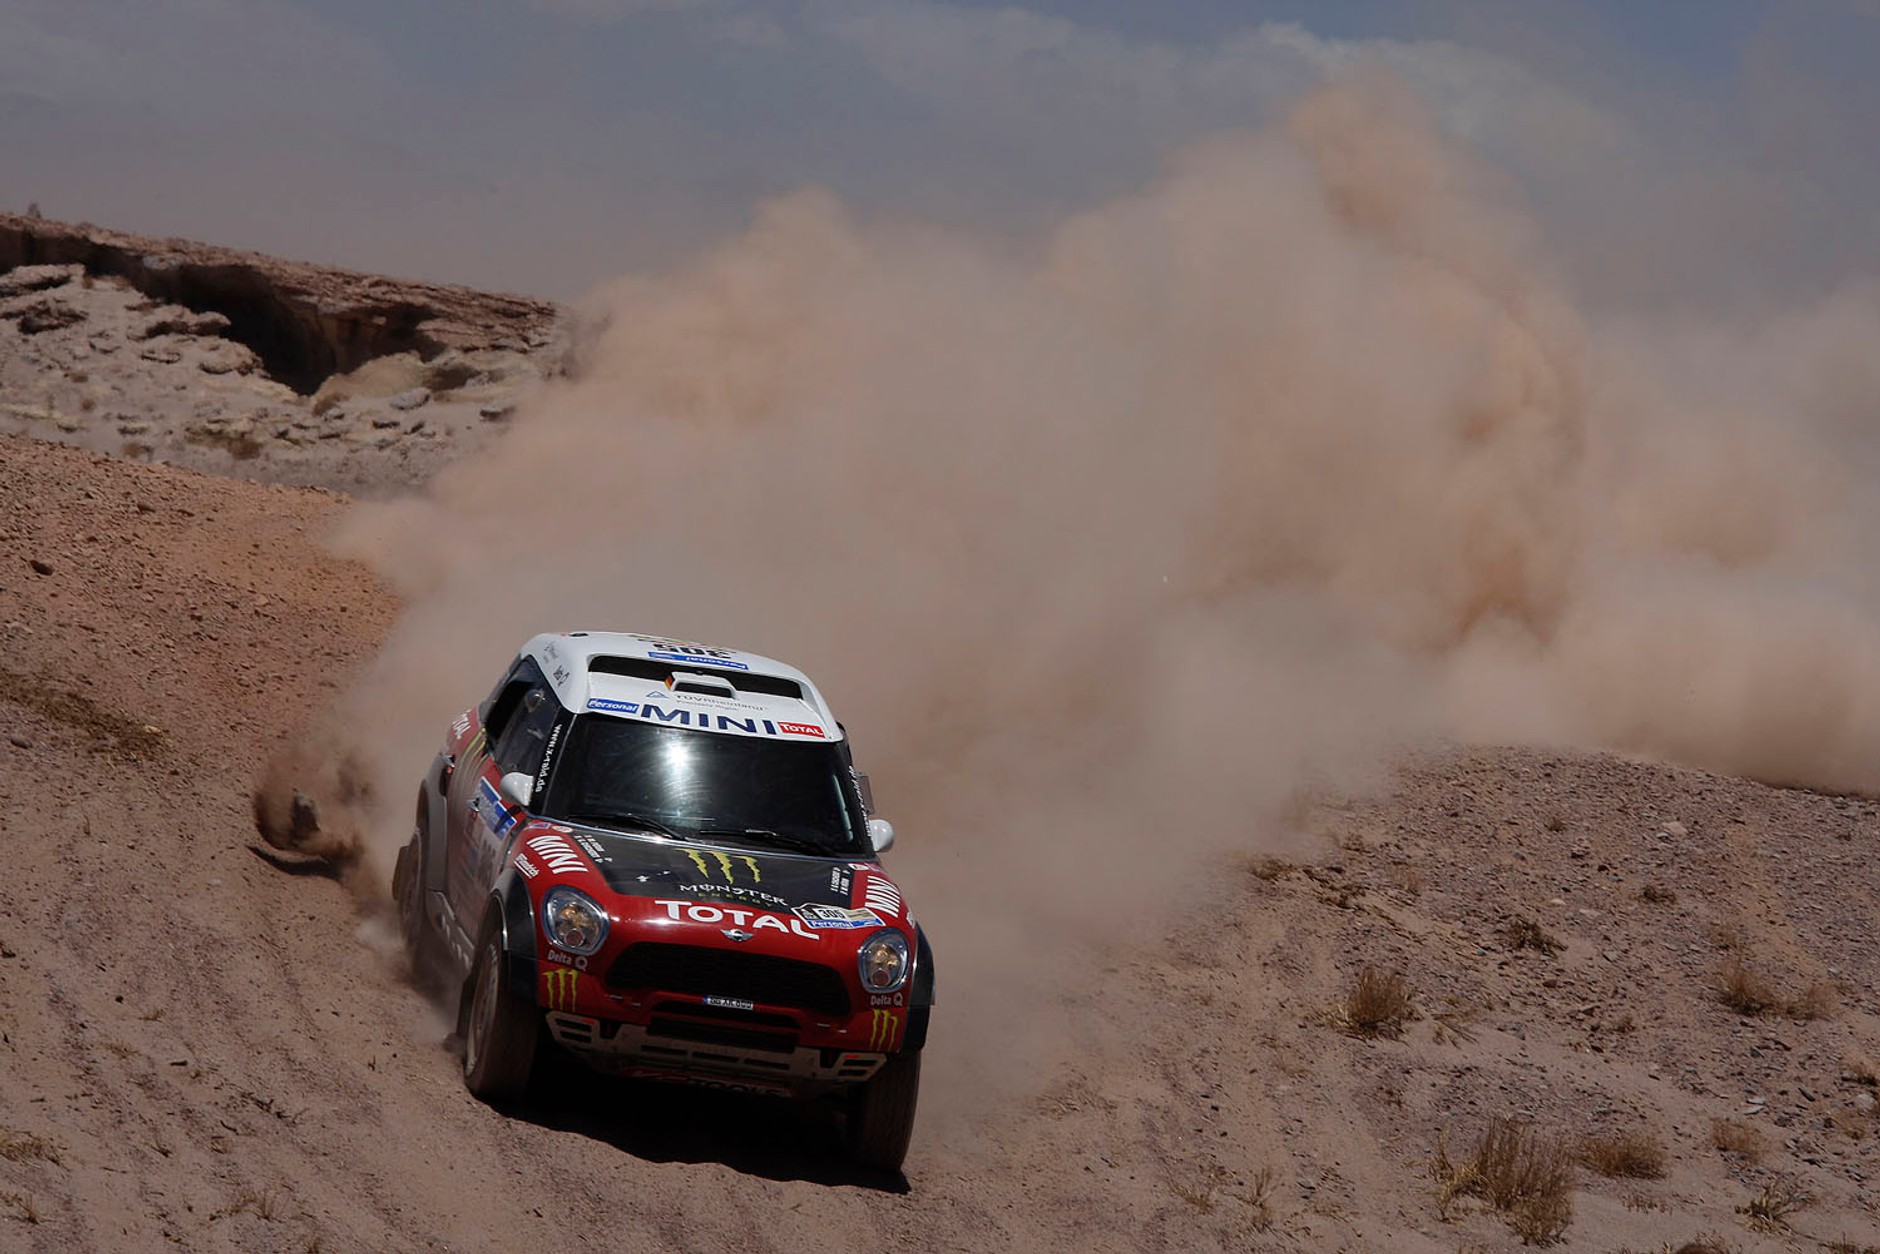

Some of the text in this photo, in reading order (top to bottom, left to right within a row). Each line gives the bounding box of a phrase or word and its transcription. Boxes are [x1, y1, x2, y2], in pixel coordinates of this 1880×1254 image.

[588, 699, 638, 713] Personal
[641, 704, 777, 735] MINI
[780, 722, 824, 738] TOTAL
[526, 835, 589, 874] MINI
[679, 884, 789, 906] MONSTER
[864, 875, 901, 918] MINI
[654, 900, 820, 940] TOTAL
[812, 920, 854, 928] Personal
[547, 950, 588, 972] Delta Q
[870, 992, 904, 1007] Delta Q
